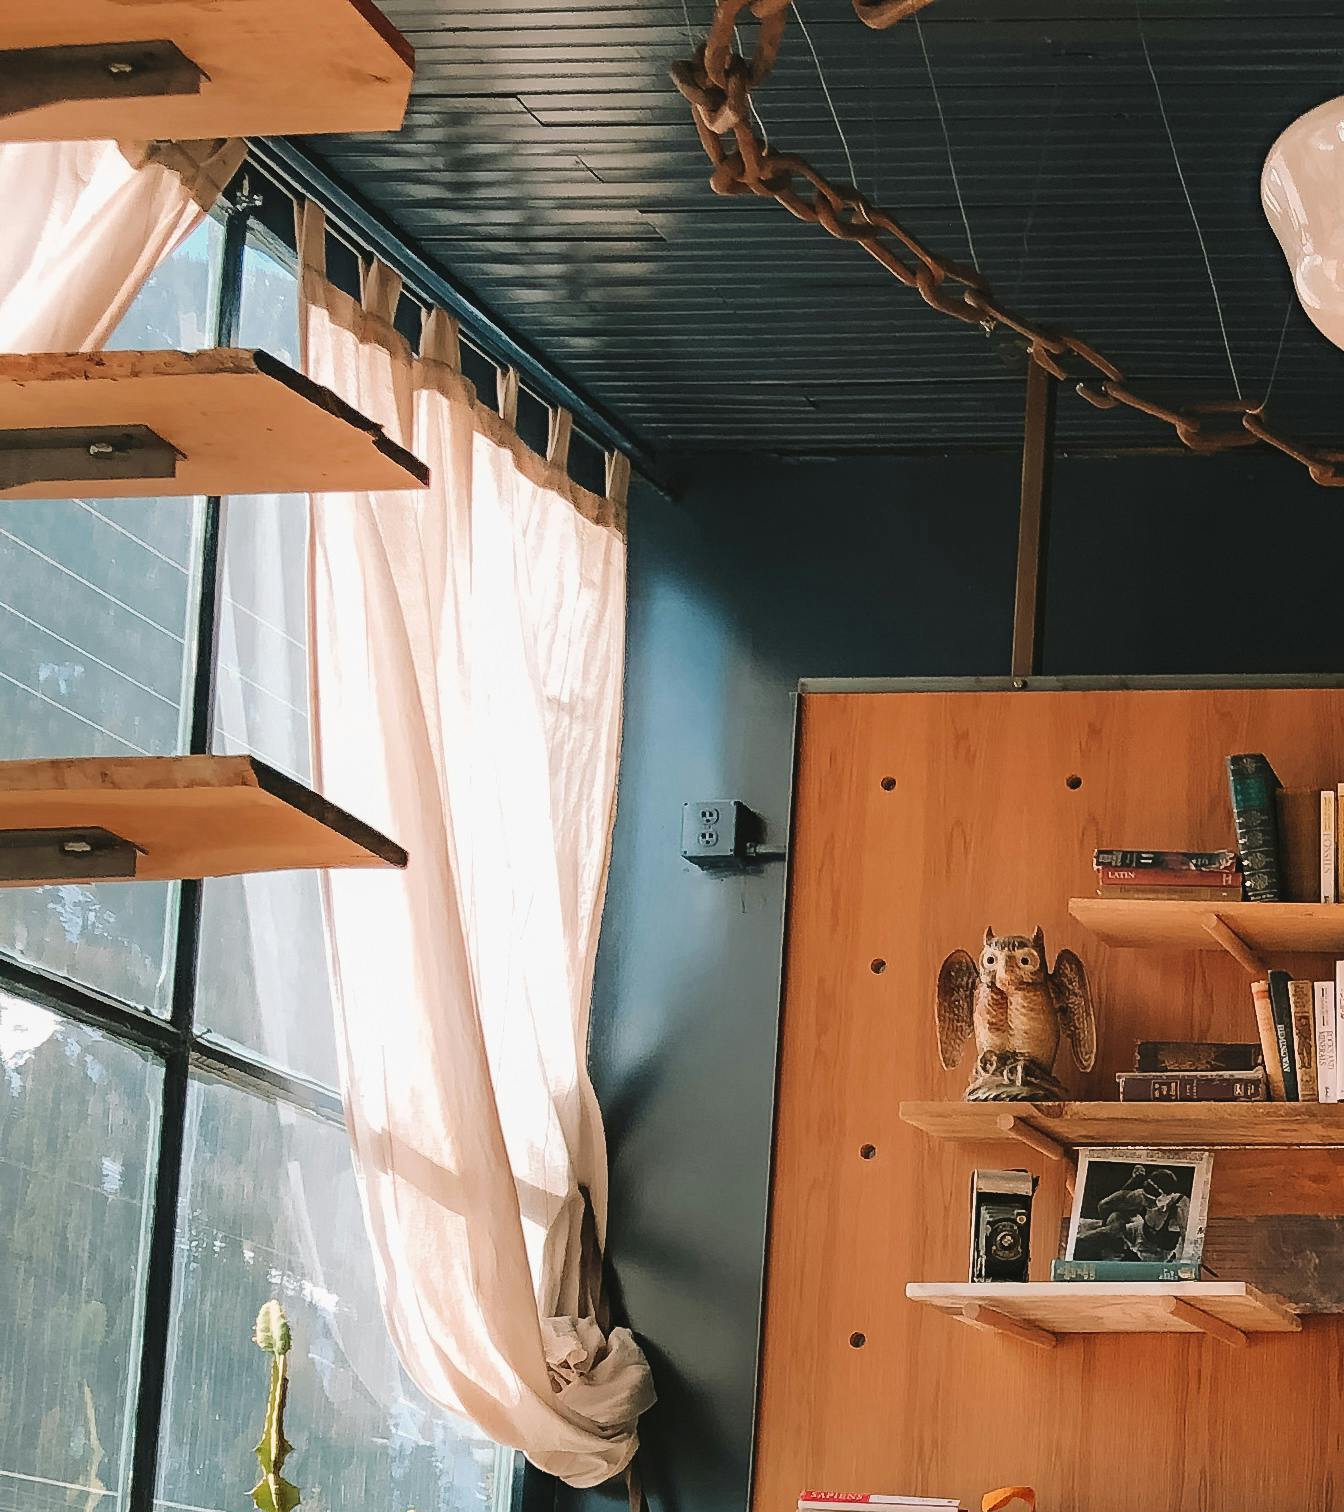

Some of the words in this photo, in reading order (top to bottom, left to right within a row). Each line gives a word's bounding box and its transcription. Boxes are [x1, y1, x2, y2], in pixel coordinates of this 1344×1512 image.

[1323, 833, 1331, 874] FOSSILS
[1108, 871, 1136, 879] LATIN
[1276, 1024, 1290, 1073] HEMINGWAY
[810, 1491, 863, 1500] SAPIENS
